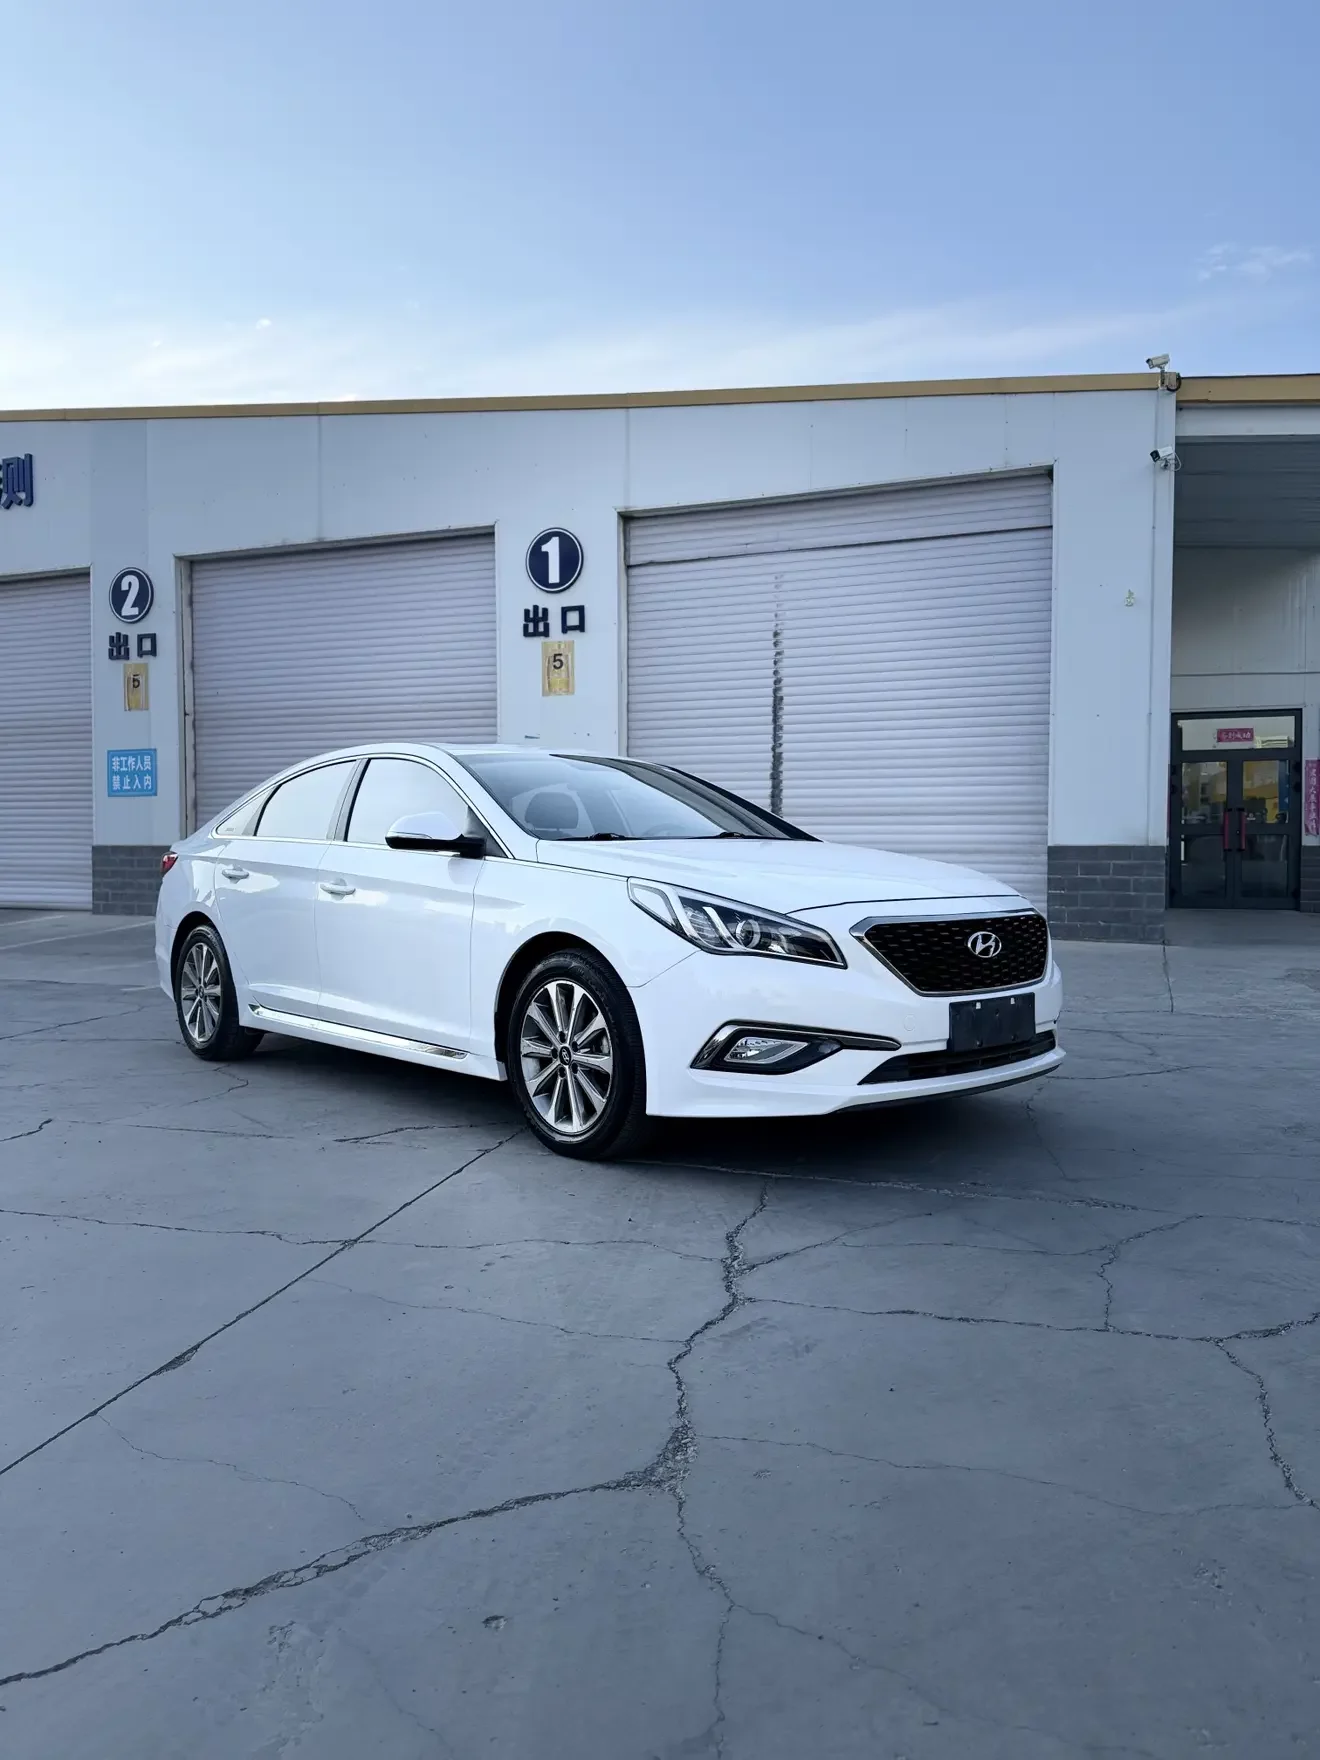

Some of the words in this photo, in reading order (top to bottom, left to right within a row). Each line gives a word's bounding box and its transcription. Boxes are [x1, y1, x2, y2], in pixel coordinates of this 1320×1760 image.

[541, 536, 560, 584] 1
[121, 574, 140, 617] 2
[523, 604, 585, 638] 出口
[108, 631, 158, 661] 出口
[552, 653, 564, 670] 5
[132, 674, 141, 689] 5
[112, 755, 152, 771] 非工作人员
[112, 774, 152, 790] 禁止入内
